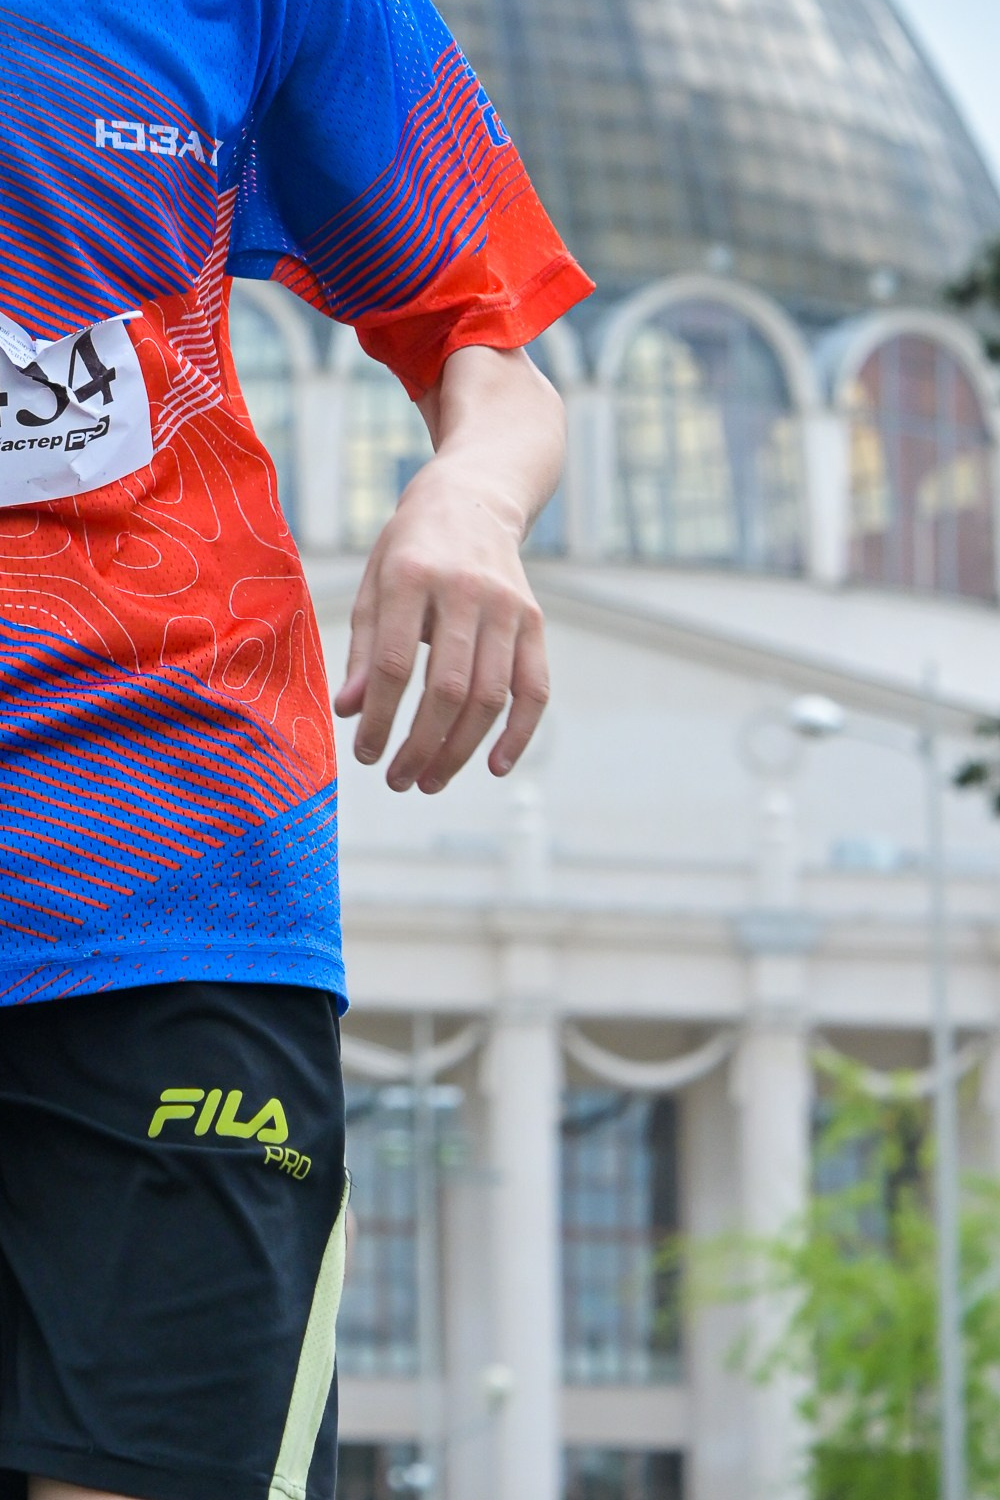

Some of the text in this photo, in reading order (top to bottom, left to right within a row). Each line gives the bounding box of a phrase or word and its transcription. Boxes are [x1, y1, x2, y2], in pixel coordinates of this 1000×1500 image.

[95, 118, 224, 167] ЮЗА
[148, 1088, 289, 1144] FILA
[264, 1145, 312, 1180] PRO
